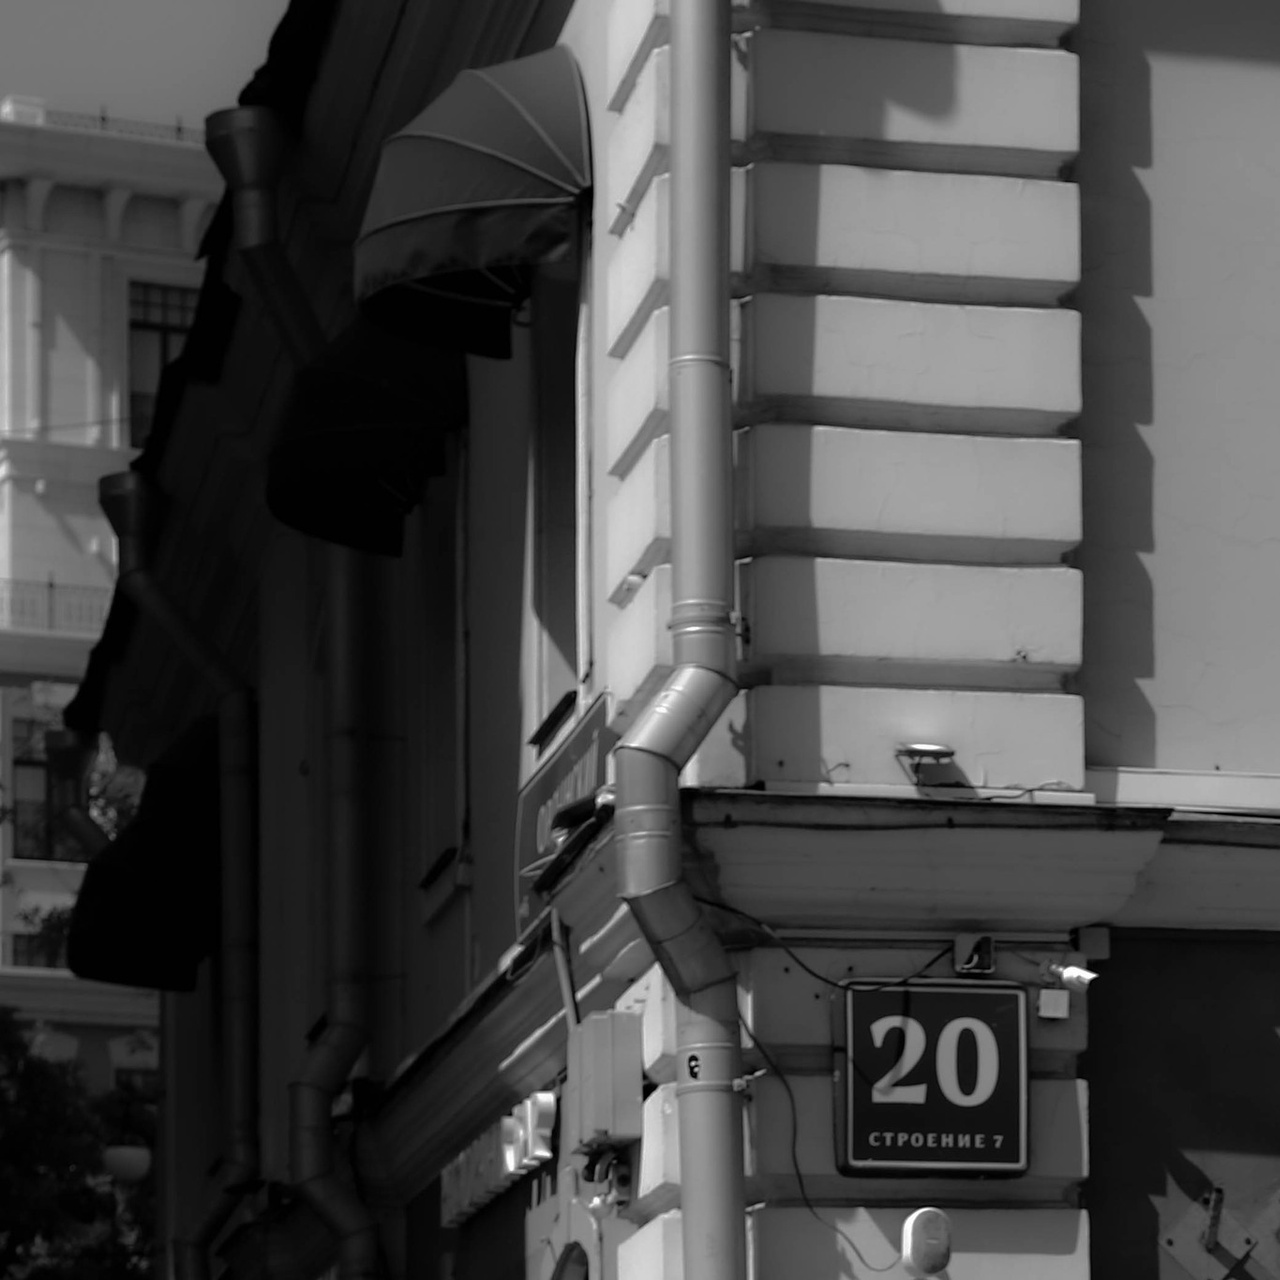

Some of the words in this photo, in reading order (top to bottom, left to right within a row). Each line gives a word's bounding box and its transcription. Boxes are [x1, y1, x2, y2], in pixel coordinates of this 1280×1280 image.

[869, 1014, 1000, 1108] 20
[868, 1131, 986, 1149] СТРОЕНИЕ
[993, 1135, 1004, 1149] 7
